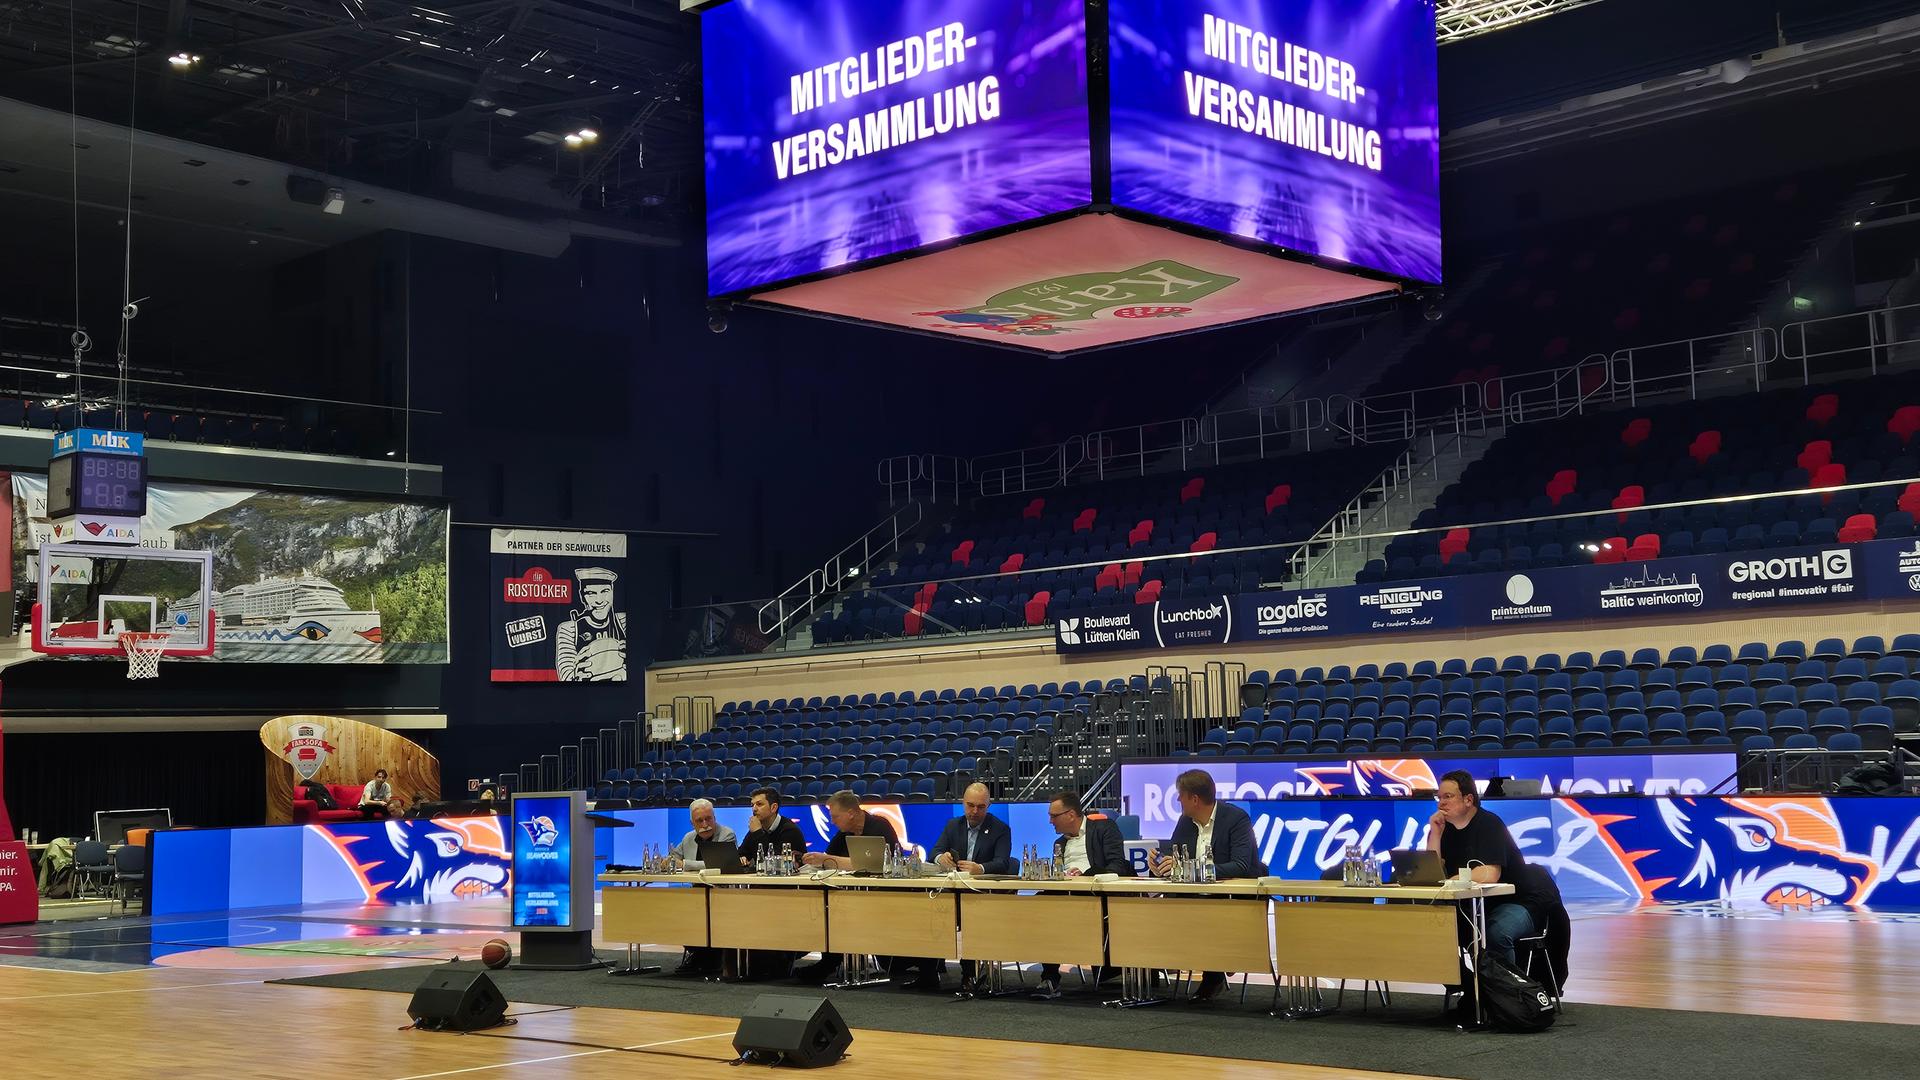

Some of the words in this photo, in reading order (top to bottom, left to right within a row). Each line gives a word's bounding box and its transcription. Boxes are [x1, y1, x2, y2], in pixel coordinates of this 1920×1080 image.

[1203, 13, 1365, 104] MITGLIEDER-
[791, 22, 977, 115] MITGLIEDER-
[772, 75, 1000, 179] VERSAMMLUNG
[1184, 70, 1382, 170] VERSAMMLUNG
[979, 267, 1212, 317] Karls
[1022, 281, 1069, 298] 1921
[35, 530, 51, 543] ist
[107, 529, 135, 539] AIDA
[507, 541, 544, 551] PARTNER
[546, 543, 563, 551] DER
[565, 544, 611, 553] SEAWOLVES
[60, 569, 87, 579] AIDA
[532, 571, 543, 582] die
[1729, 556, 1820, 582] GROTH
[507, 583, 568, 598] ROSTOCKER
[1360, 590, 1442, 605] REINIGUNG
[1732, 588, 1775, 600] #regional
[1778, 585, 1828, 597] #innovativ
[1831, 583, 1854, 593] #fair
[1601, 595, 1635, 608] baltic
[1637, 591, 1702, 606] weinkontor
[1160, 603, 1223, 624] Lunchbox
[1257, 595, 1328, 626] rogatec
[1491, 605, 1552, 620] printzentrum
[509, 618, 541, 634] KLASSE
[1084, 614, 1131, 629] Boulevard
[511, 629, 542, 644] WURST
[1085, 630, 1116, 644] Lütten
[1117, 628, 1141, 641] Klein
[1187, 629, 1212, 639] FRESHER
